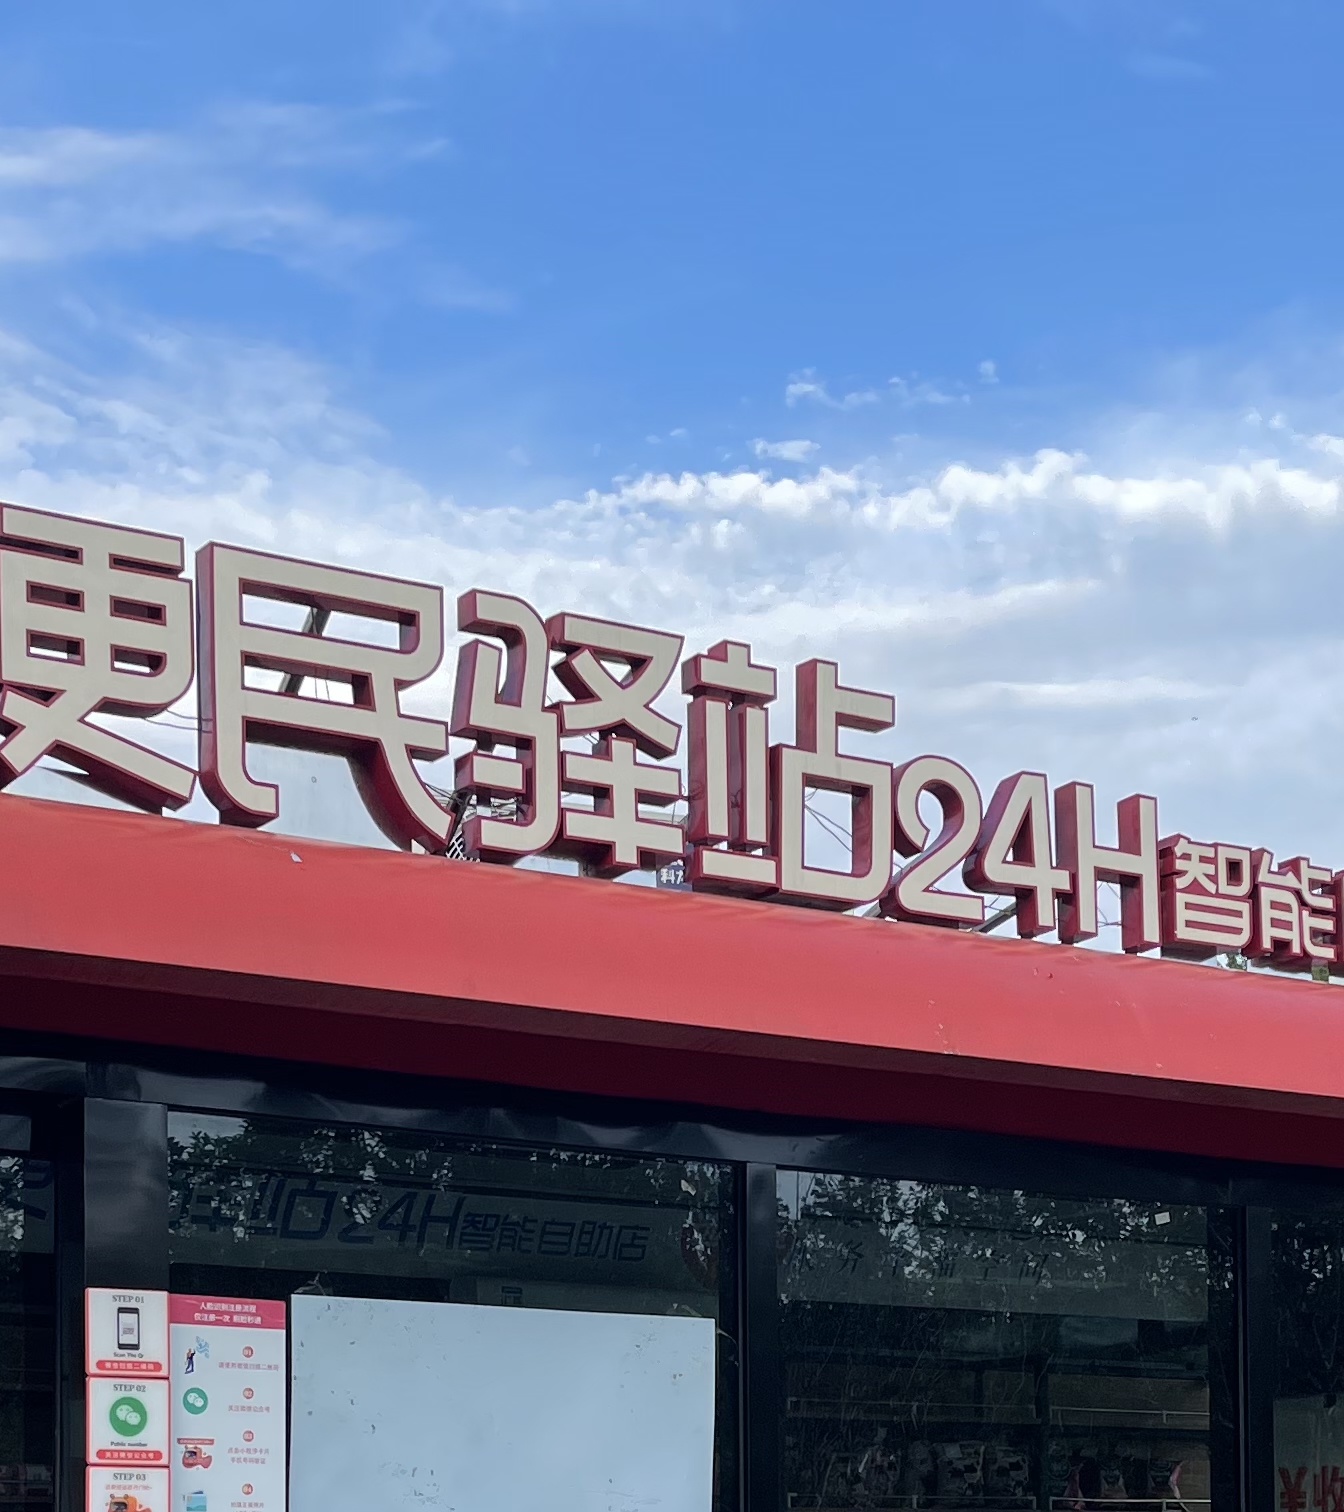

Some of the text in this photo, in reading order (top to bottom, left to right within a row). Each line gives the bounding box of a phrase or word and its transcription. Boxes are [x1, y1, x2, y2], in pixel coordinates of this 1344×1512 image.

[112, 1294, 145, 1304] STEP 01
[113, 1383, 146, 1392] STEP 02
[113, 1472, 146, 1481] STEP 03
